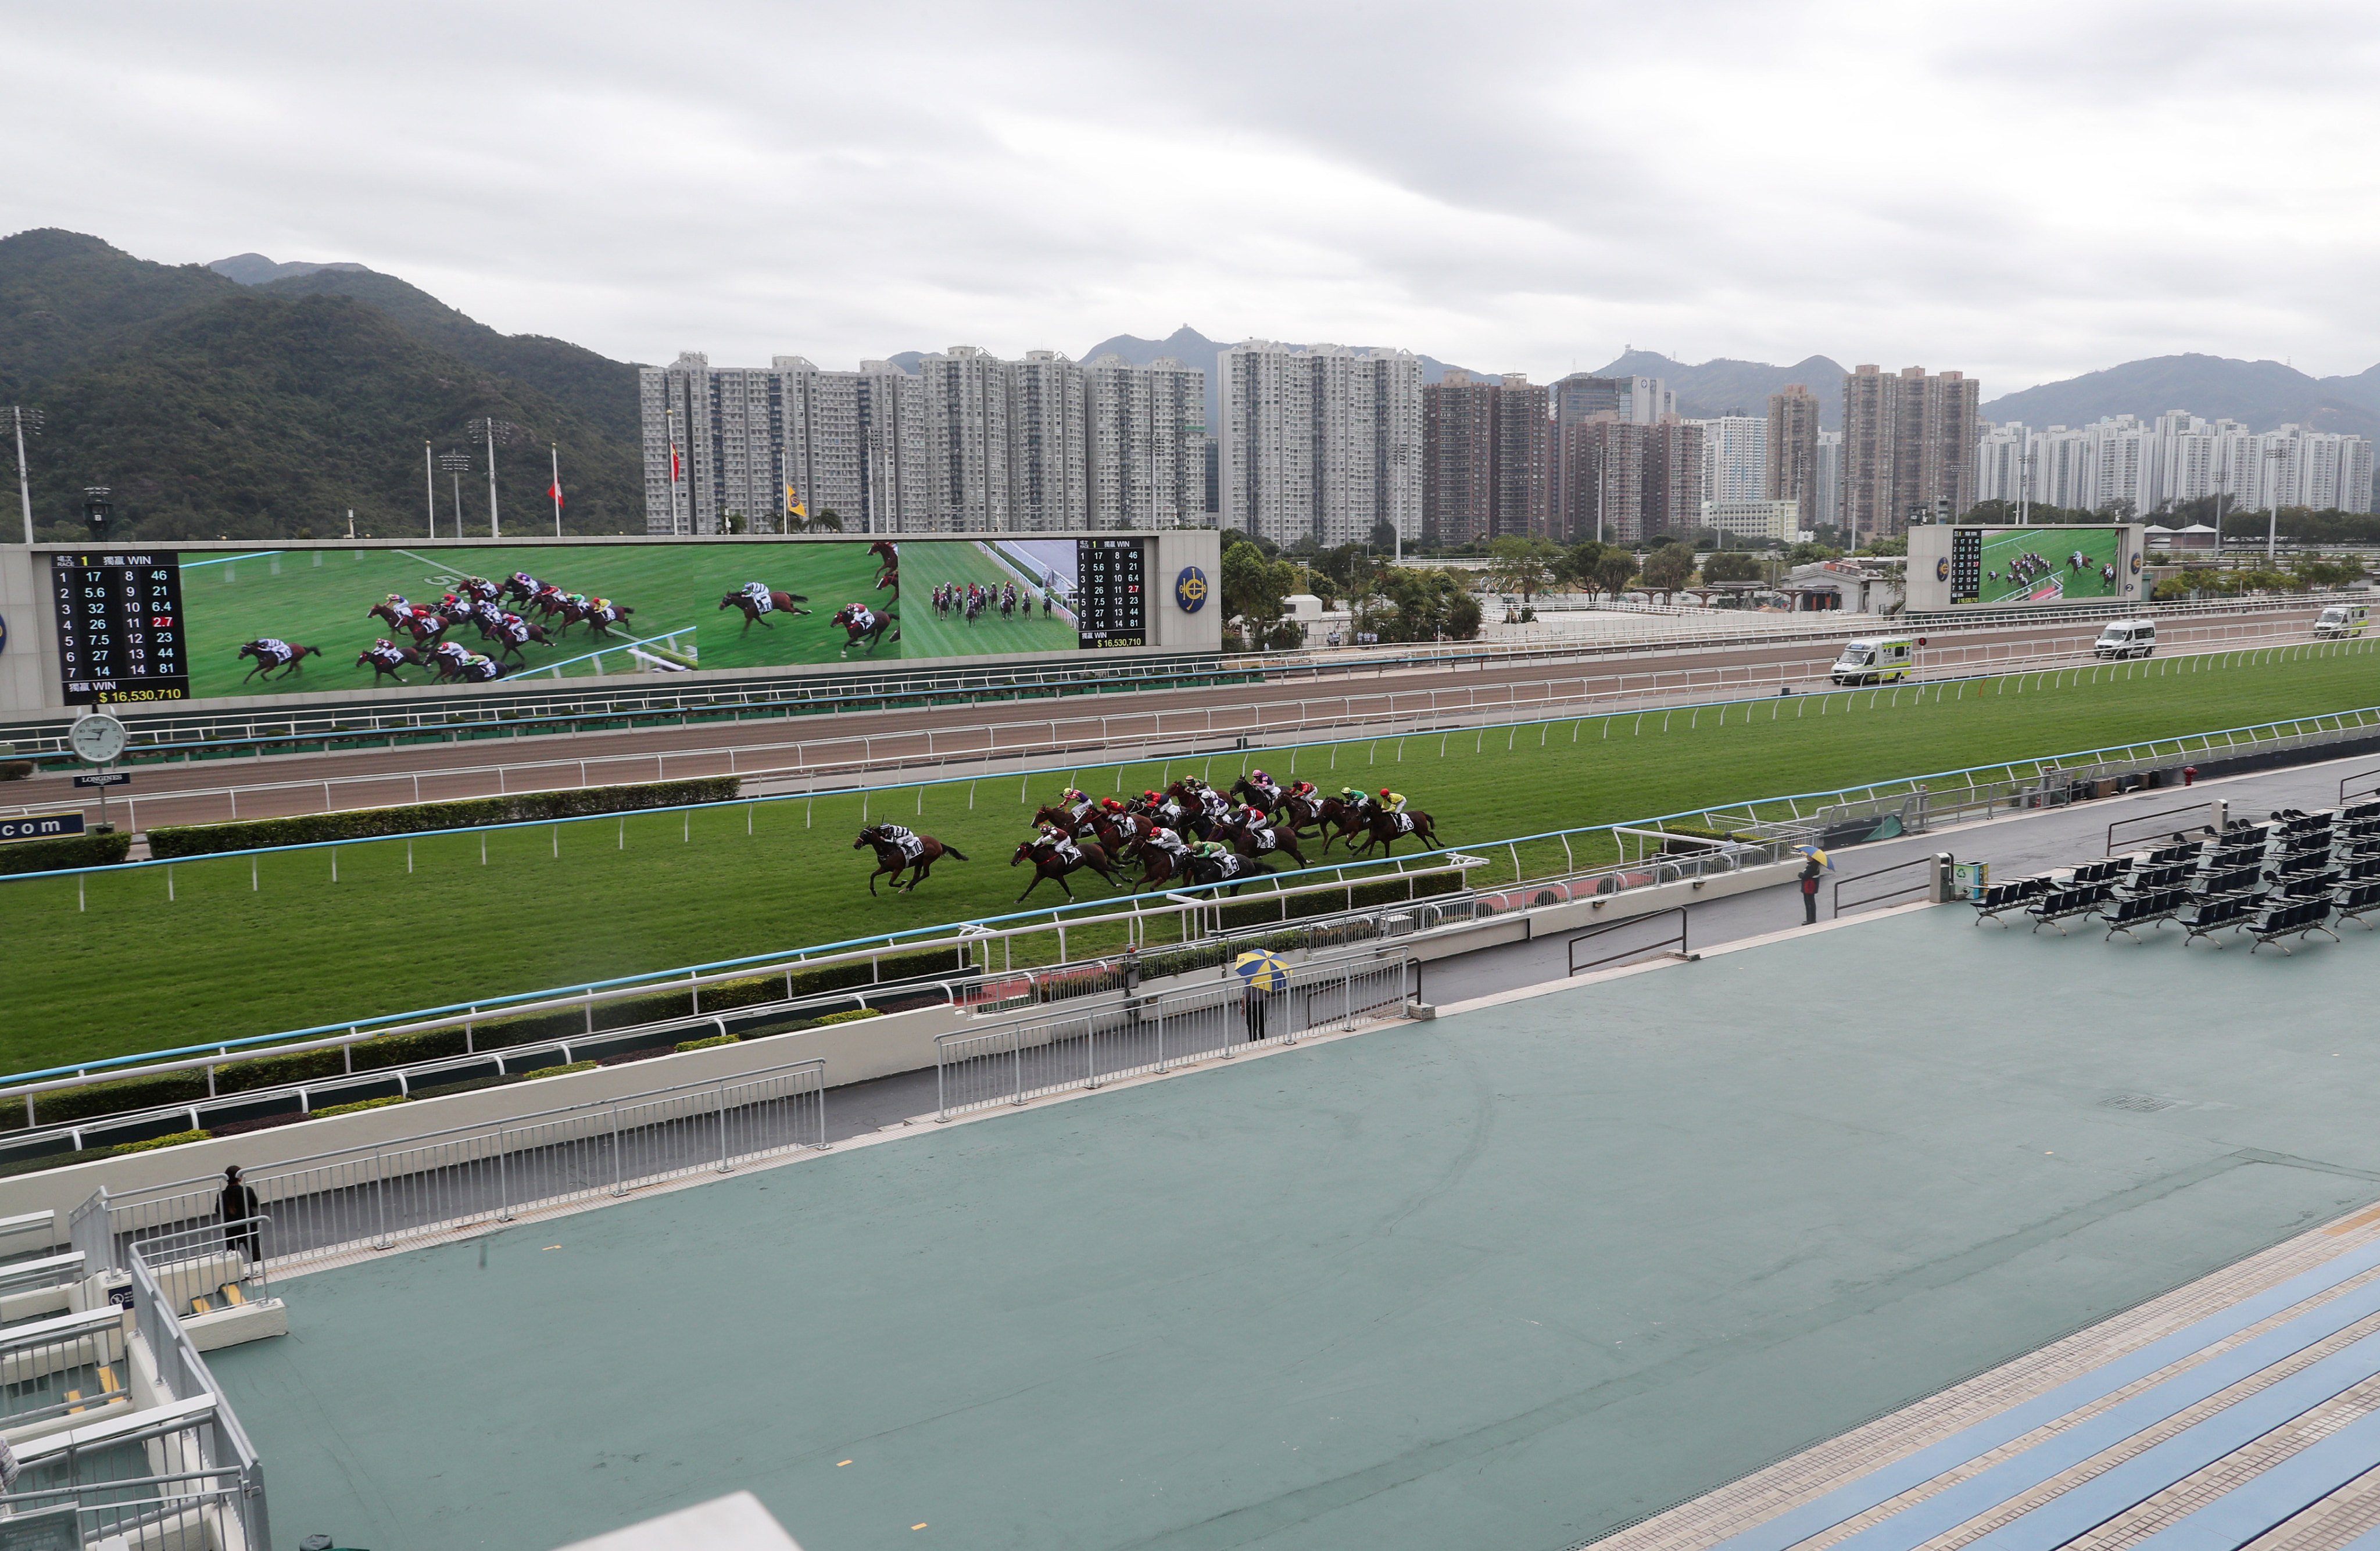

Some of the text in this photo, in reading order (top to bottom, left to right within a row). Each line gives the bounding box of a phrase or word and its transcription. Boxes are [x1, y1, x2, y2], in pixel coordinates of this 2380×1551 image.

[81, 556, 88, 566] 1
[127, 556, 151, 564] WIN
[60, 571, 167, 582] 1 17 8 46
[60, 586, 166, 598] 2 5.6 9 21
[62, 601, 171, 614] 3 32 10 6.4
[63, 617, 172, 630] 4 26 11 2.7
[66, 633, 172, 646] 5 7.5 12 23
[1104, 639, 1141, 647] 16,530,710
[67, 648, 173, 661] 6 27 13 44
[68, 664, 173, 677] 7 14 14 81
[93, 682, 116, 690] WIN
[99, 689, 181, 703] $ 16,530,710
[82, 774, 122, 782] LONGINES
[2, 820, 60, 836] com
[1406, 819, 1413, 829] 6
[913, 841, 923, 854] 10
[1269, 836, 1275, 847] 8
[1230, 858, 1239, 871] 5
